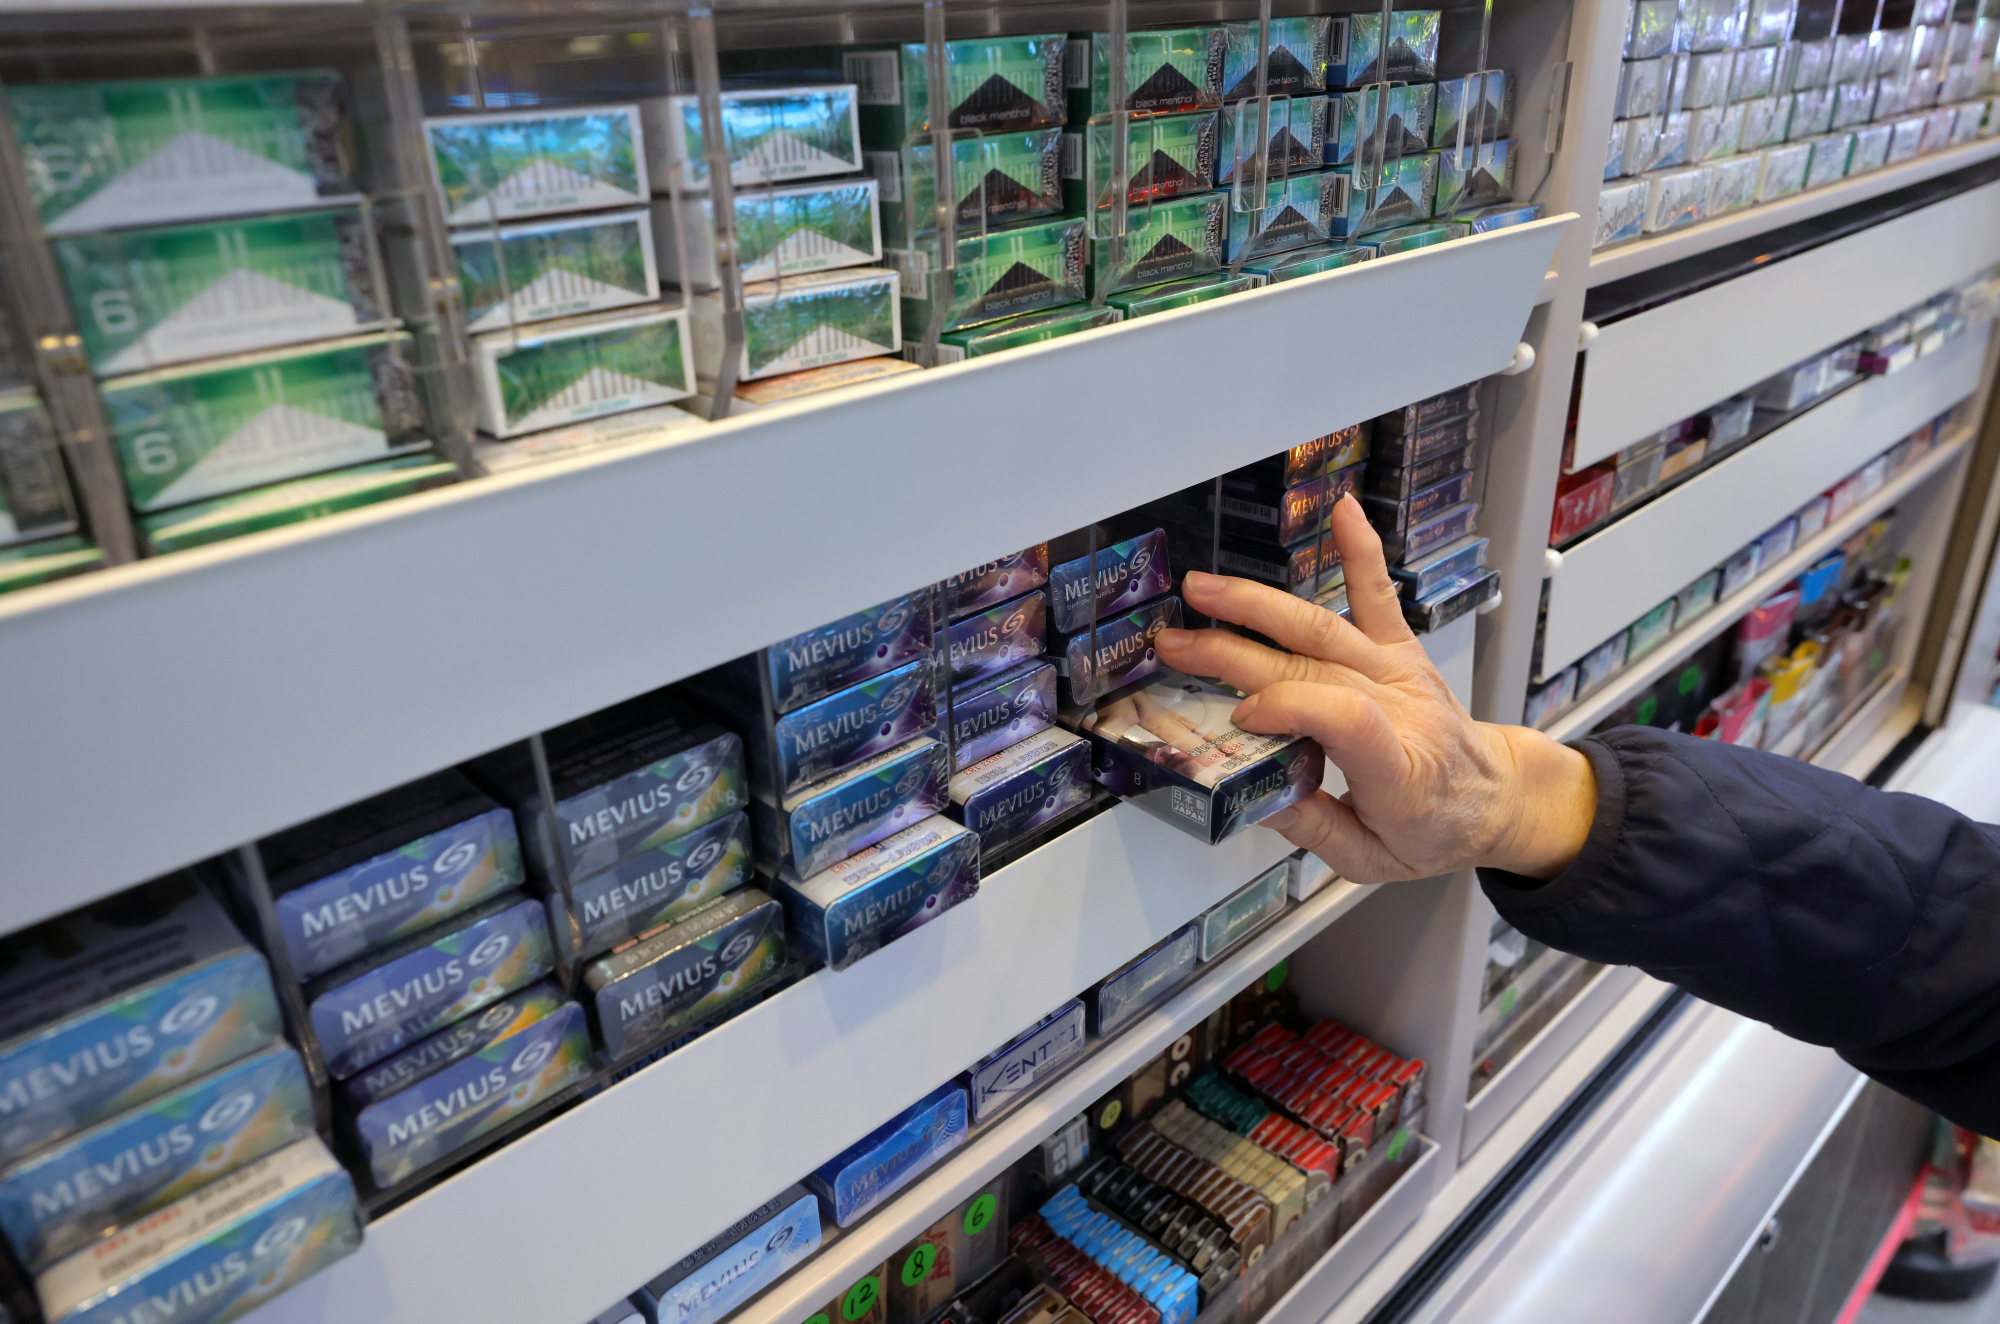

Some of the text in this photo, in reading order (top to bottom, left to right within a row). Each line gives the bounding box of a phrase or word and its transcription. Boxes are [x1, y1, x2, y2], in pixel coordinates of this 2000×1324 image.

[960, 107, 1031, 125] black menthol
[1135, 96, 1193, 109] black menthol
[988, 200, 1028, 215] menthol
[1137, 260, 1193, 279] black menthol
[91, 290, 138, 335] 6
[985, 290, 1051, 311] black menthol
[133, 431, 178, 475] 6
[1065, 562, 1128, 602] MEVIUS
[788, 622, 875, 673] MEVIUS
[927, 626, 999, 669] MEVIUS
[1083, 631, 1145, 674] MEVIUS
[795, 703, 877, 755] MEVIUS
[940, 702, 1010, 745] MEVIUS
[1133, 772, 1141, 786] 8
[1223, 768, 1285, 815] MEVIUS
[569, 783, 673, 846] MEVIUS
[725, 789, 737, 806] 8
[810, 787, 892, 842] MEVIUS
[980, 780, 1045, 829] MEVIUS
[1174, 804, 1206, 823] JAPAN
[301, 864, 430, 939] MEVIUS
[583, 860, 683, 924] MEVIUS
[844, 879, 924, 937] MEVIUS
[341, 958, 465, 1036] MEVIUS
[620, 954, 717, 1022] MEVIUS
[0, 1024, 154, 1114] MEVIUS
[981, 1039, 1052, 1104] KENT
[1069, 1023, 1079, 1042] 1
[387, 1065, 507, 1147] MEVIUS
[30, 1123, 195, 1220] MEVIUS
[850, 1138, 919, 1197] MEVIUS
[971, 1201, 985, 1228] 6
[677, 1250, 761, 1319] MEVIUS
[912, 1250, 926, 1279] 8
[850, 1282, 874, 1315] 12
